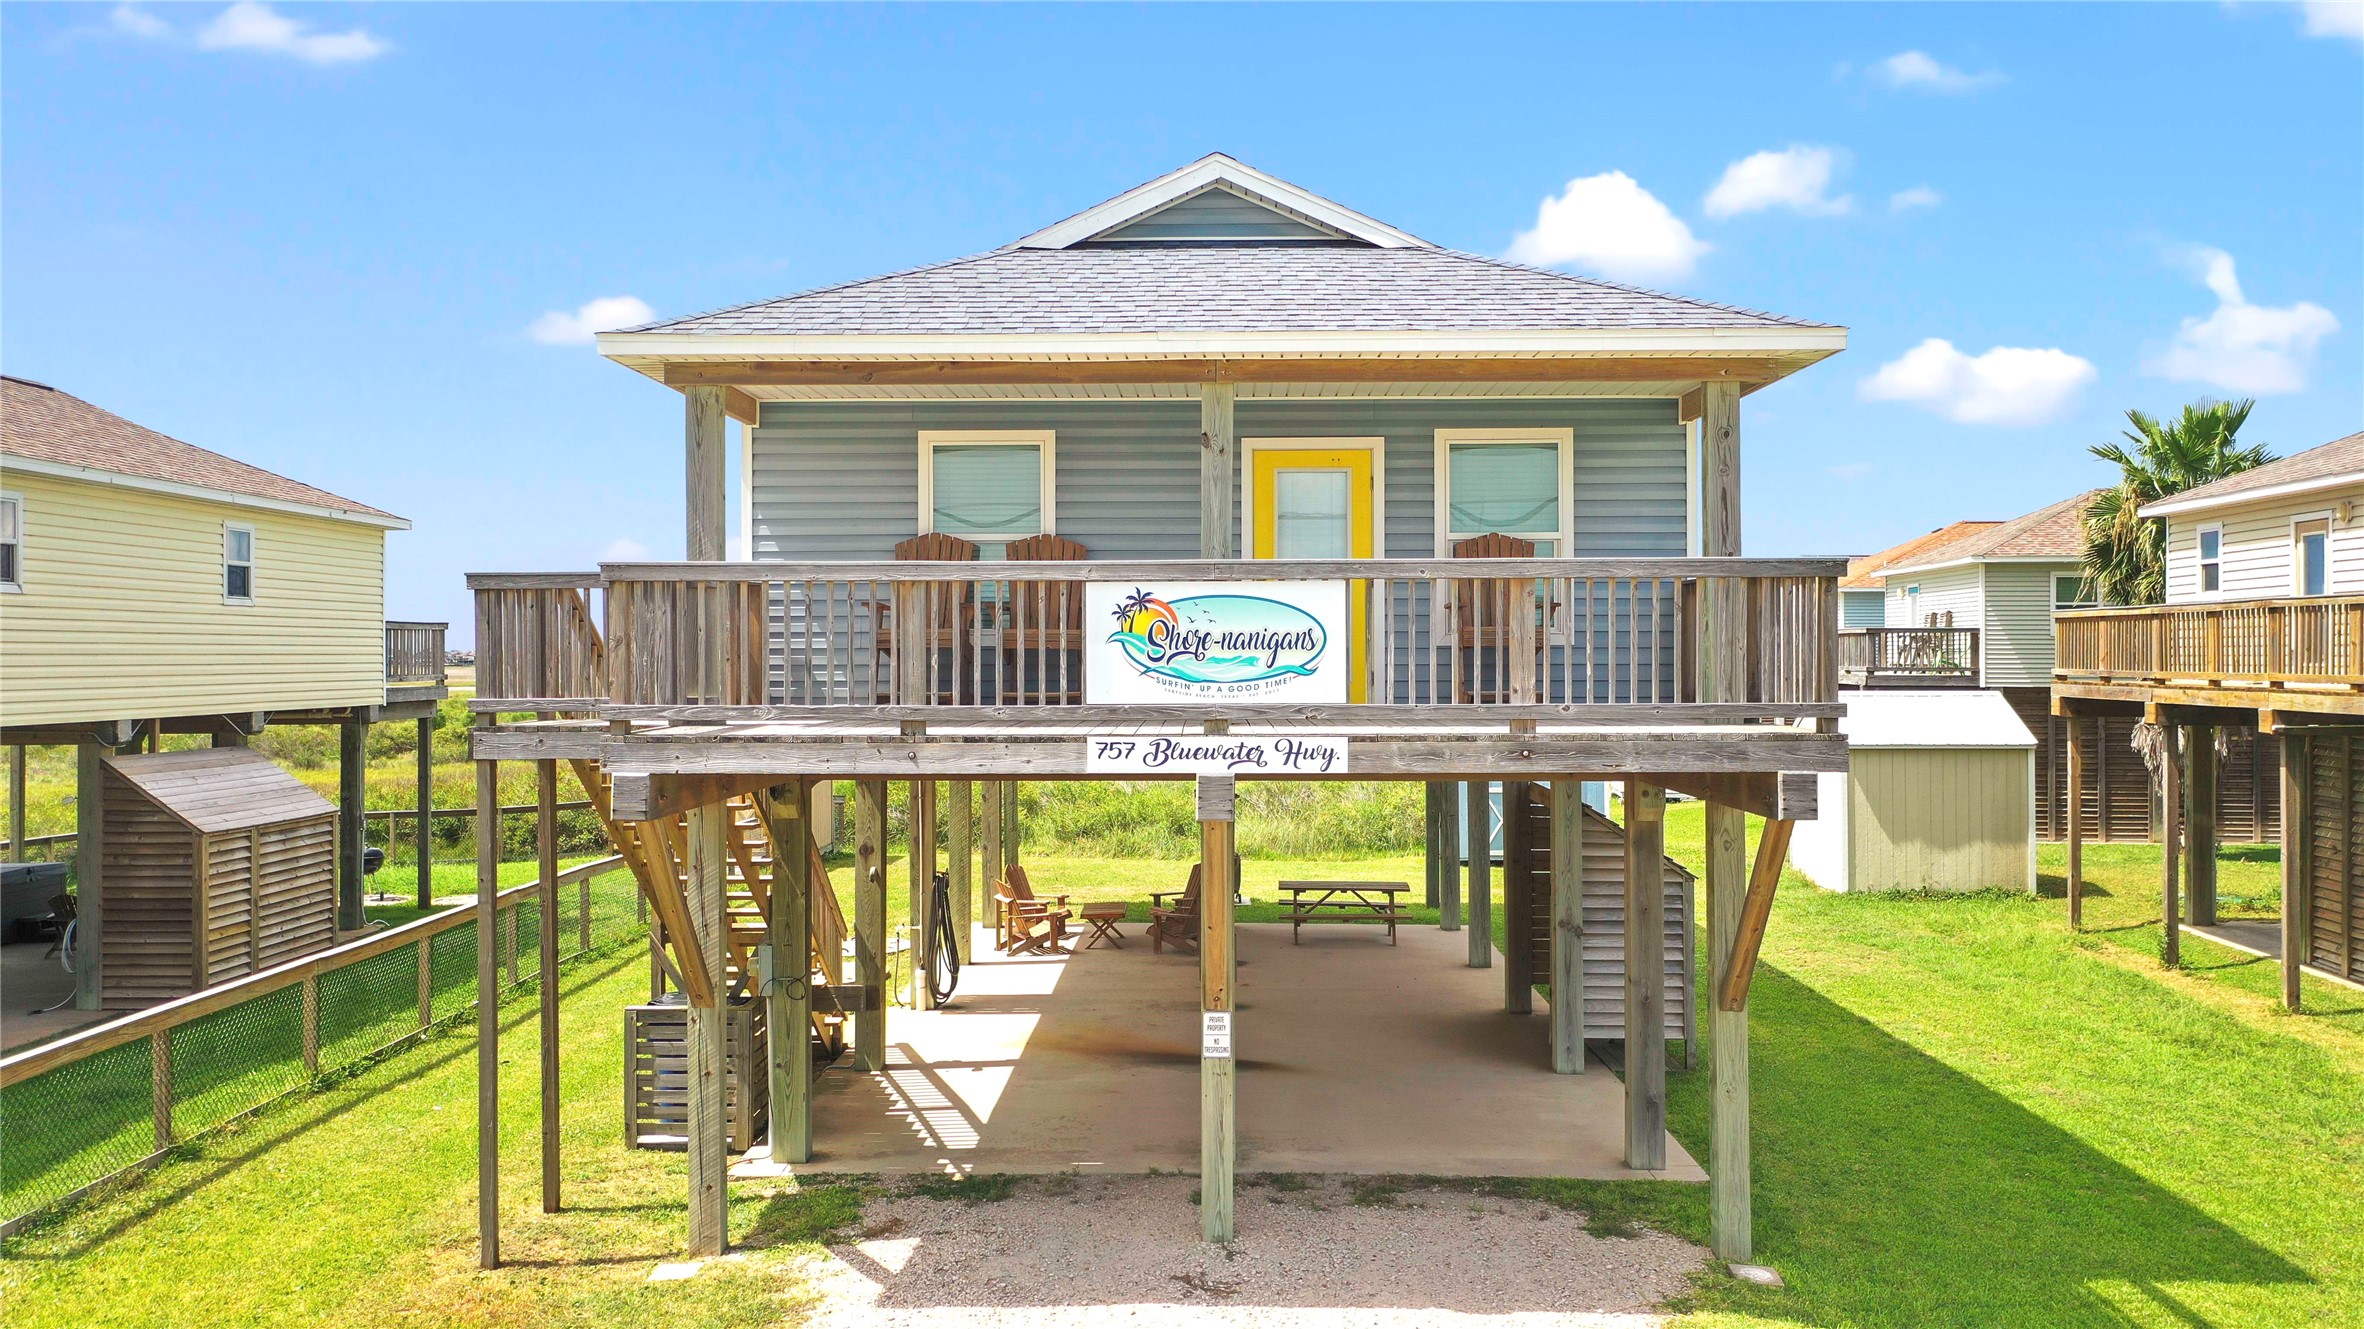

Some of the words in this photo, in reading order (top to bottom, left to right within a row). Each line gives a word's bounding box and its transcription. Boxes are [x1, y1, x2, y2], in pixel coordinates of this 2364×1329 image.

[1147, 619, 1319, 668] Shore-nanigans
[1228, 683, 1260, 692] GOOD
[1265, 676, 1292, 688] TIME!
[1095, 742, 1136, 760] 757
[1143, 738, 1268, 770] Bluewater
[1274, 738, 1340, 772] Hwy.
